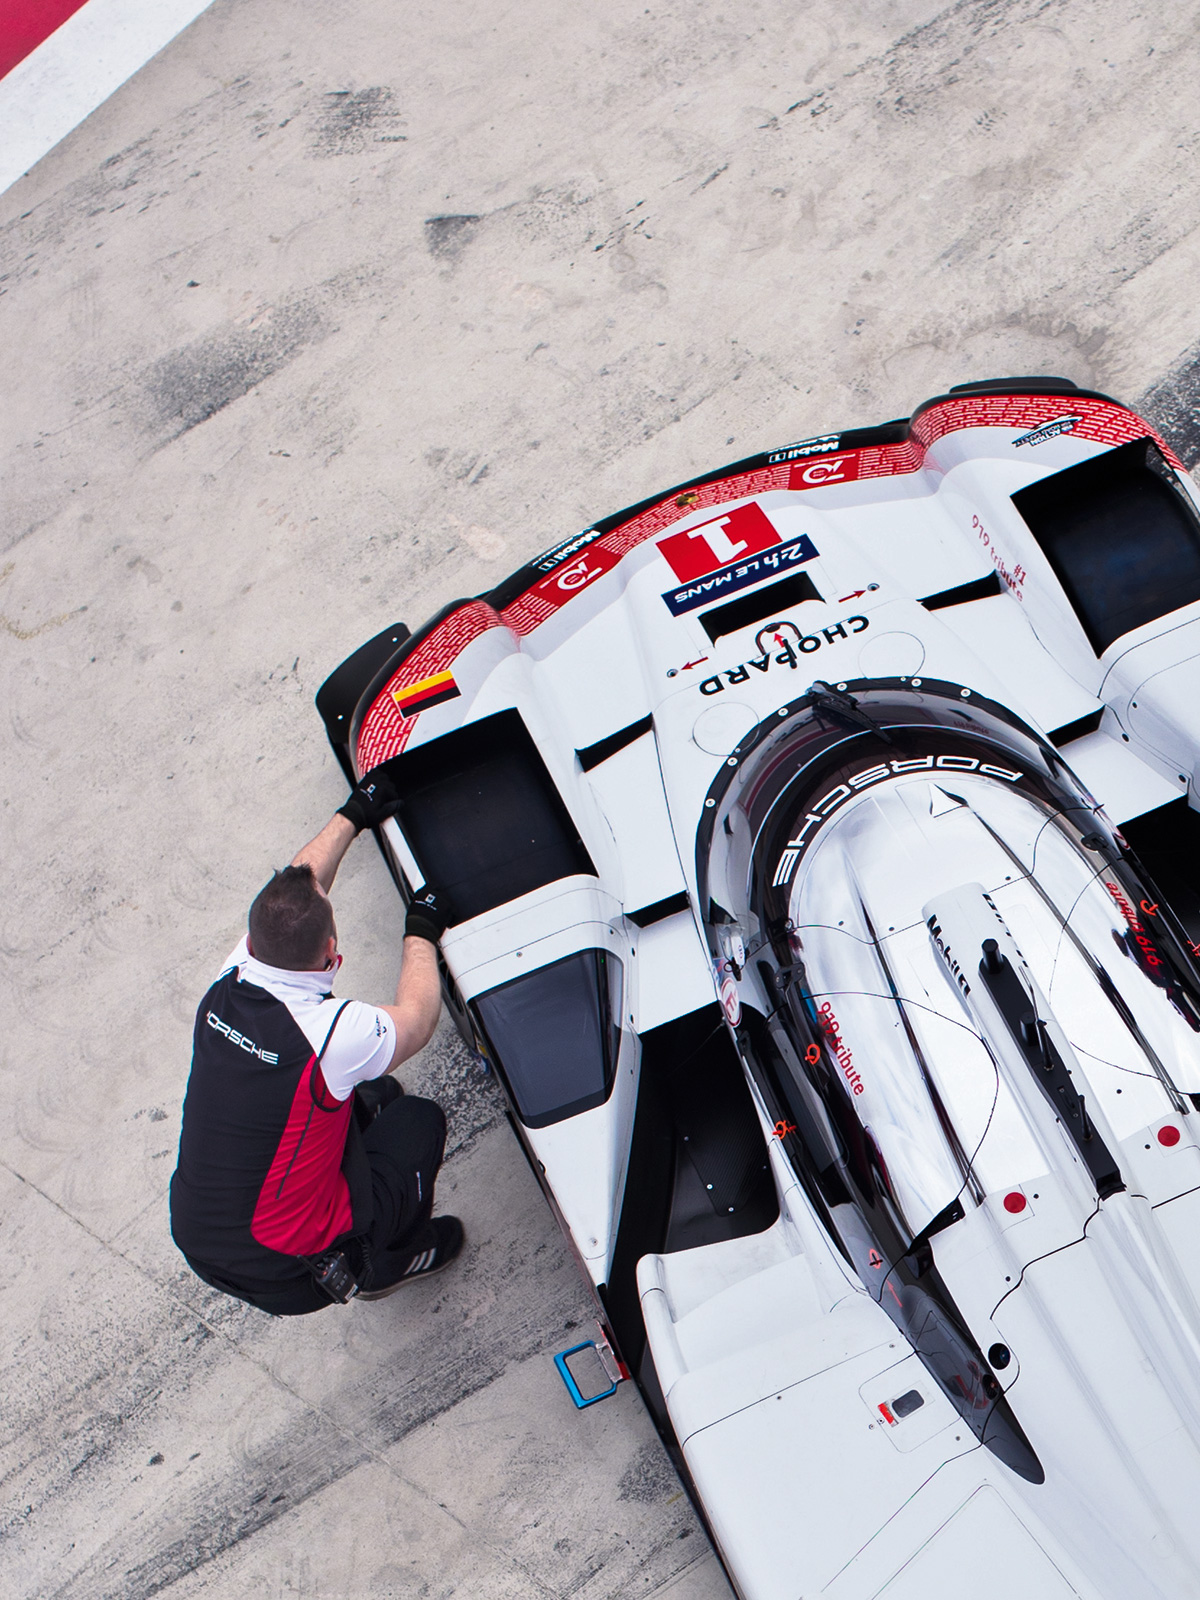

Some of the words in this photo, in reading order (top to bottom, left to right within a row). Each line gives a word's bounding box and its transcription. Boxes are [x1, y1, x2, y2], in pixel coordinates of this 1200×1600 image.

[788, 441, 839, 459] Mobil
[802, 460, 845, 484] 70
[553, 530, 601, 560] Mobil
[687, 516, 749, 564] 1
[735, 561, 759, 578] LE
[972, 514, 990, 546] 919
[991, 547, 1022, 601] tribute
[557, 561, 602, 590] 70
[674, 572, 732, 603] MANS
[1014, 564, 1026, 586] #1
[699, 615, 870, 696] CHOPARD
[772, 755, 1023, 887] PORSCHE
[1105, 881, 1145, 933] tribute
[1135, 935, 1163, 966] 919
[817, 1001, 840, 1034] 919
[831, 1036, 864, 1095] tribute
